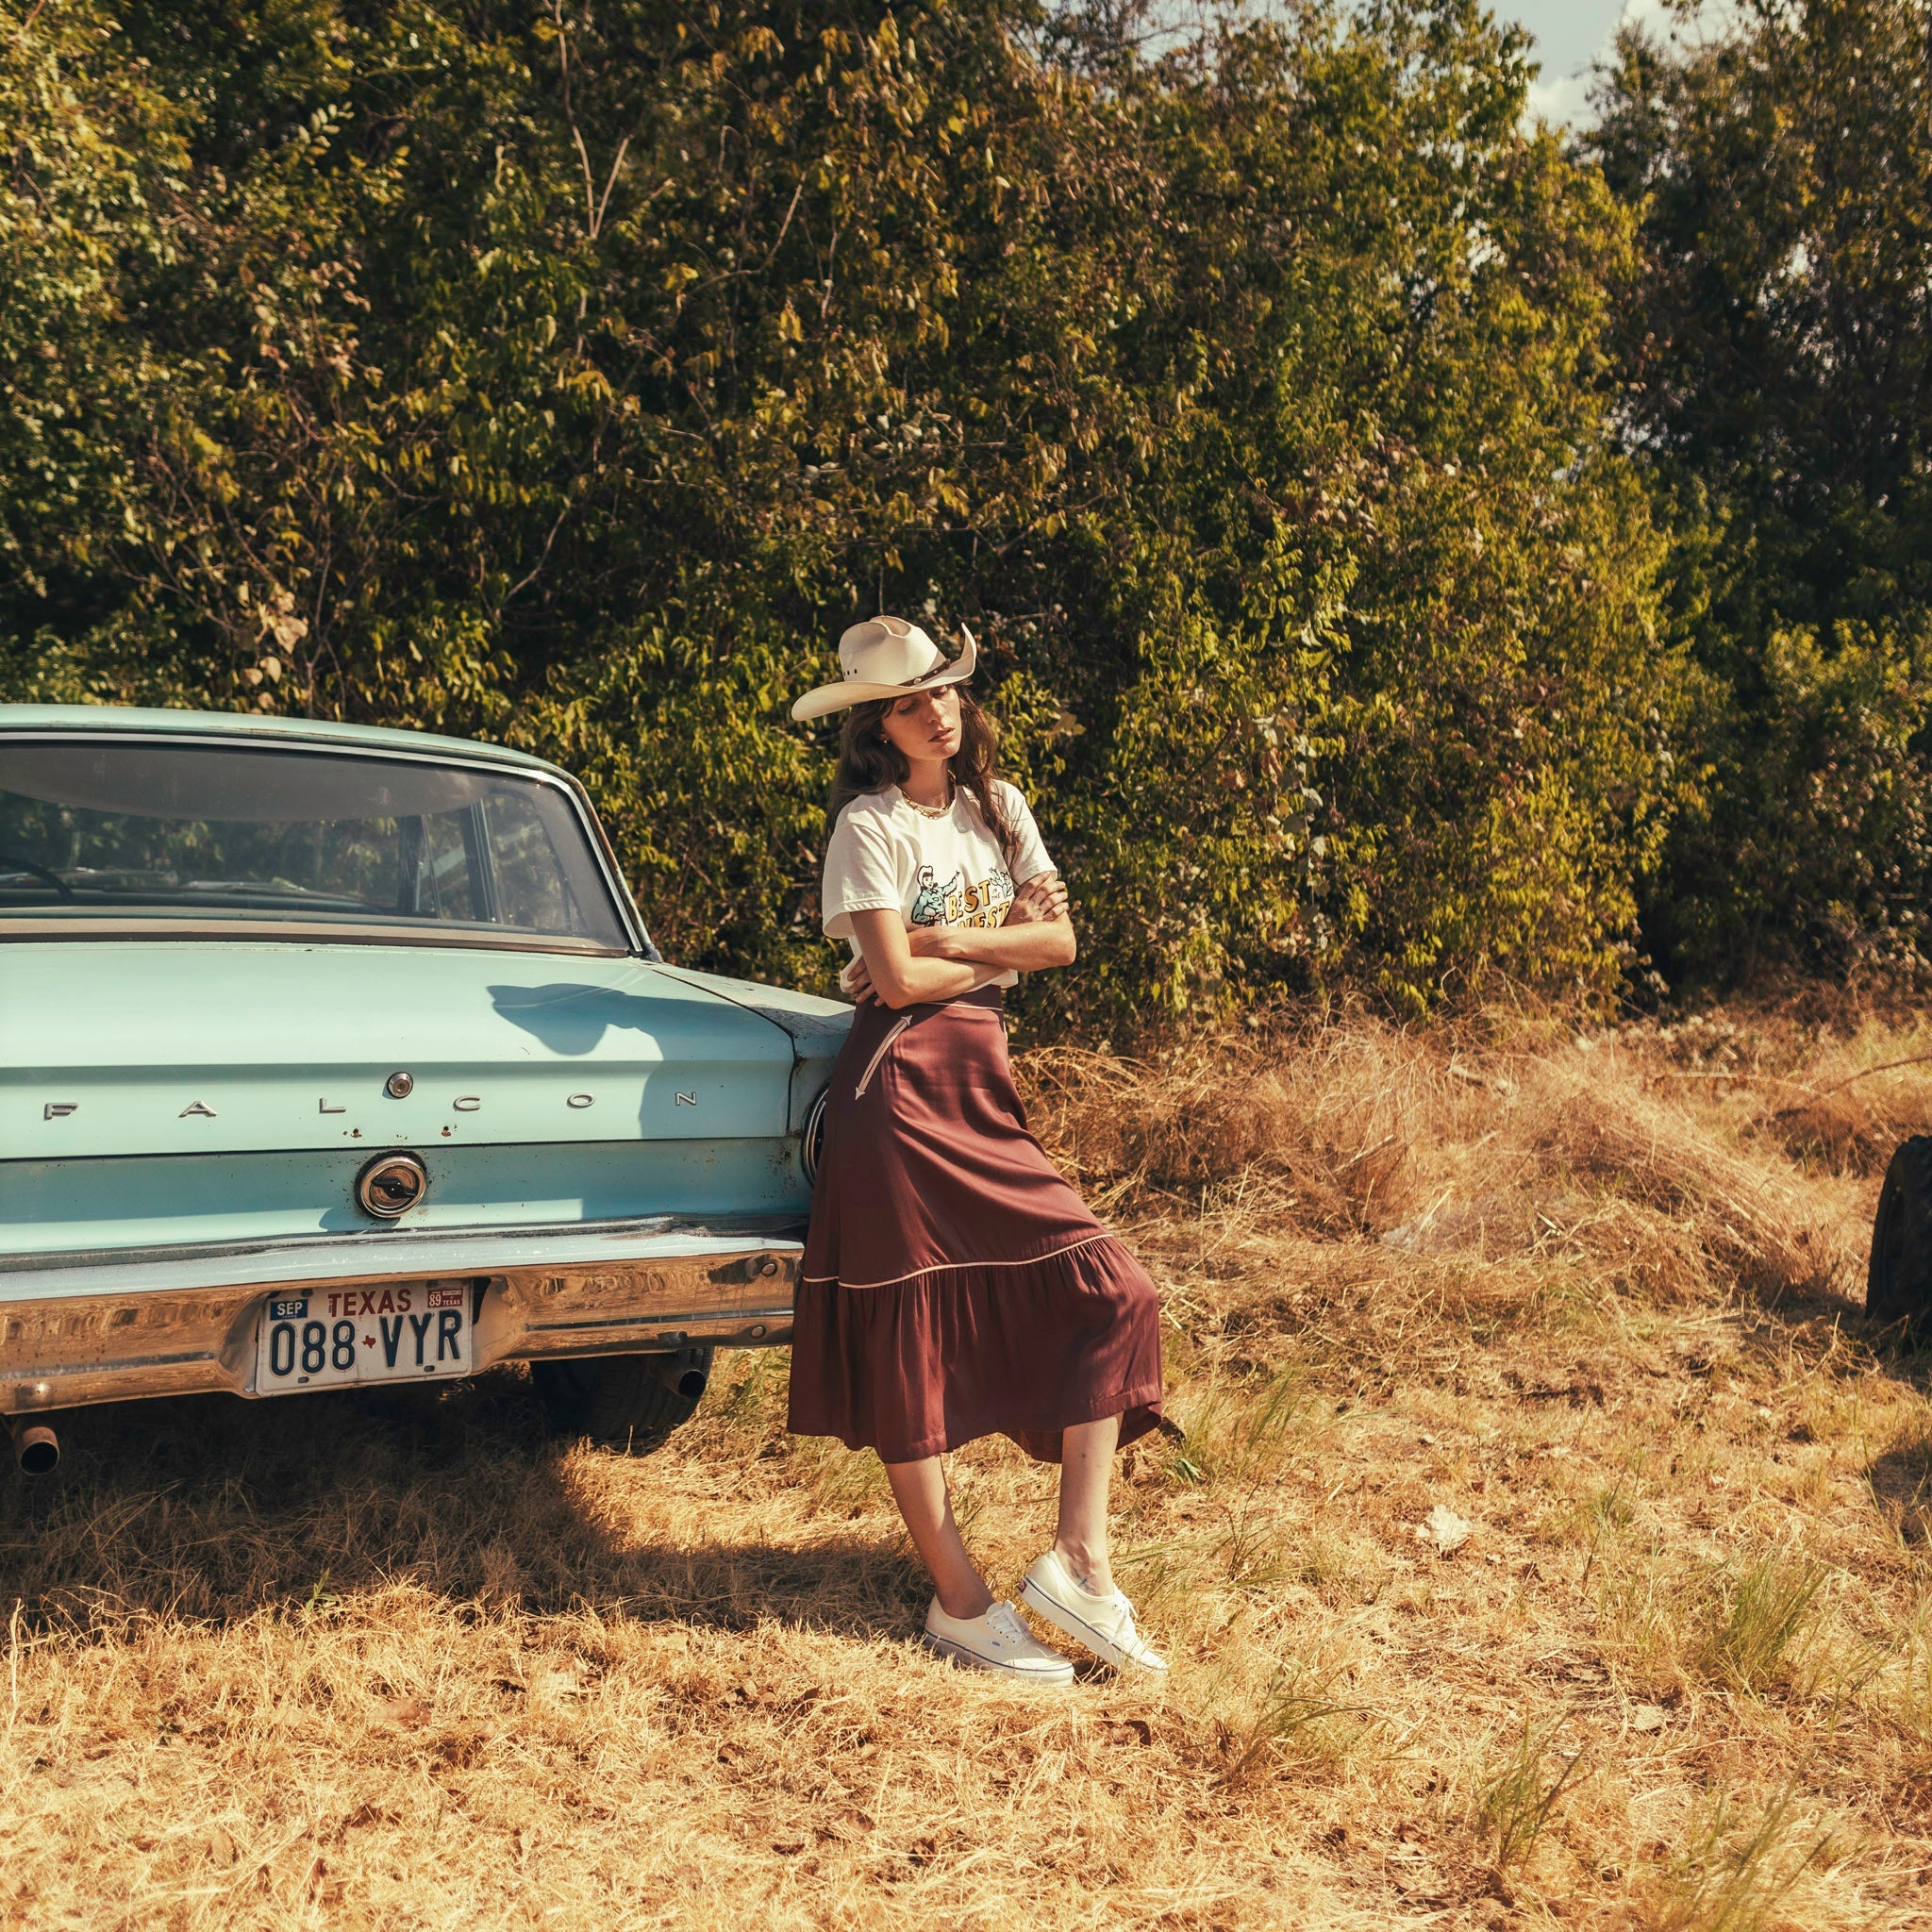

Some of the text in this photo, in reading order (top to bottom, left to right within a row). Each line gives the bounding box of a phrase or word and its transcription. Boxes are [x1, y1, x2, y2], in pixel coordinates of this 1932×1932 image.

[948, 879, 991, 924] BEST
[43, 1091, 697, 1121] FALCON
[276, 1302, 303, 1316] SEP
[327, 1289, 412, 1318] TEXAS
[428, 1293, 441, 1307] 89
[270, 1308, 462, 1376] 088 VYR
